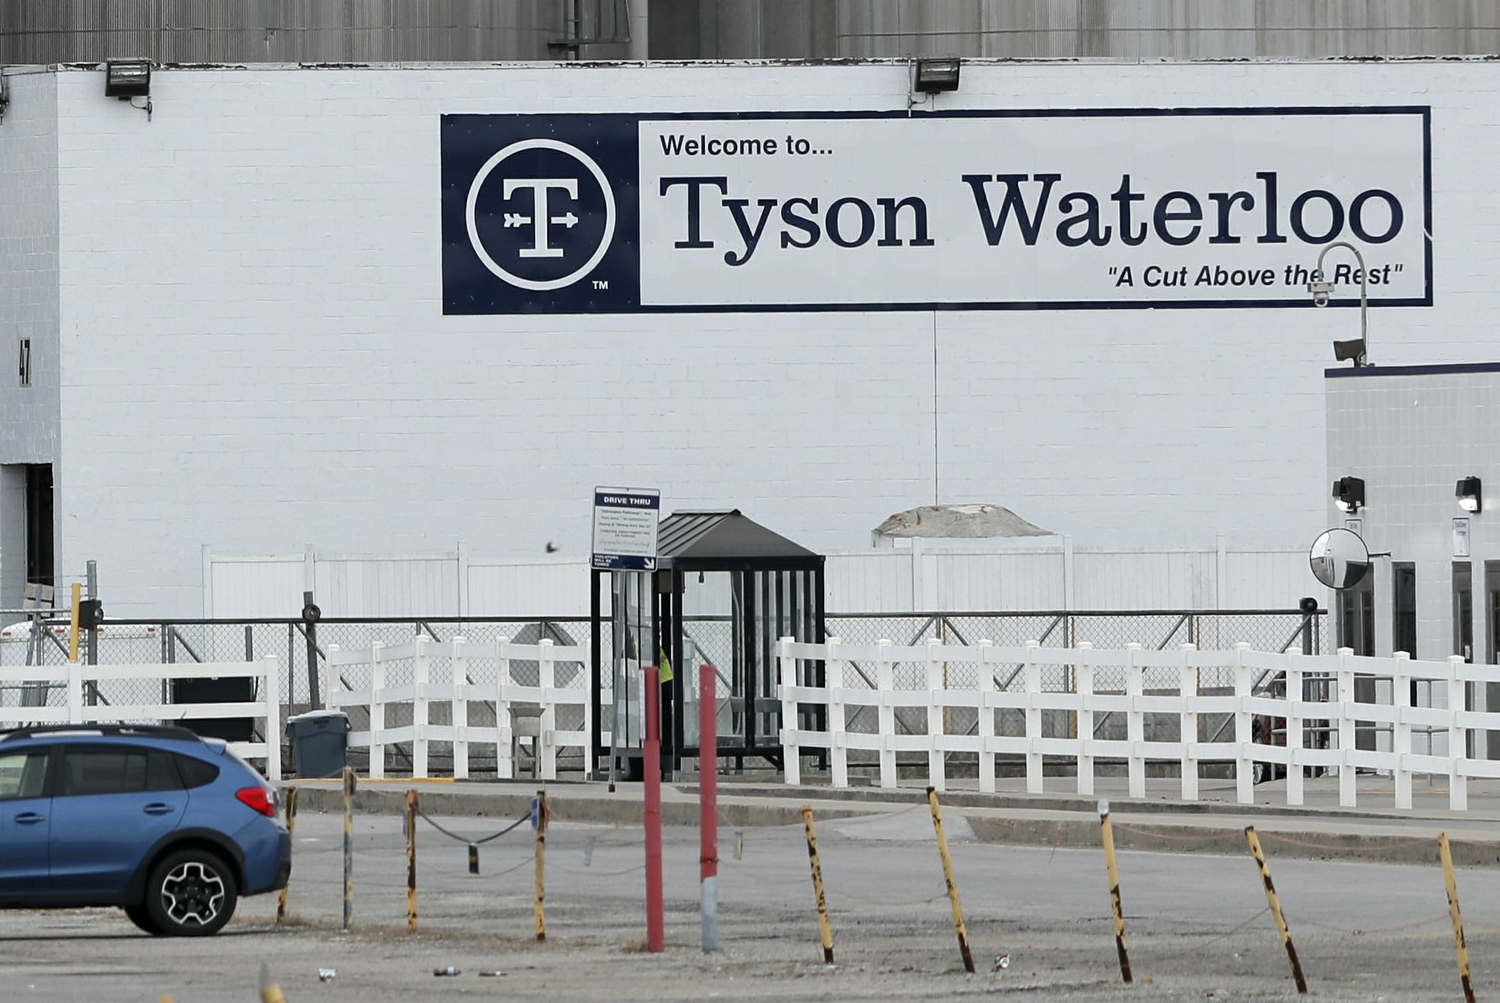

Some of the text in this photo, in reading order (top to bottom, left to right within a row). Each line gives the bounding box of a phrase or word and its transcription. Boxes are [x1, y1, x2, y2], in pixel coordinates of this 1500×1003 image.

[660, 135, 833, 156] Welcome to...
[659, 171, 1404, 267] Tyson Waterloo
[592, 280, 609, 290] TM
[1108, 264, 1404, 287] "A Cut Above the Rest"
[603, 496, 651, 506] DRIVE THRU
